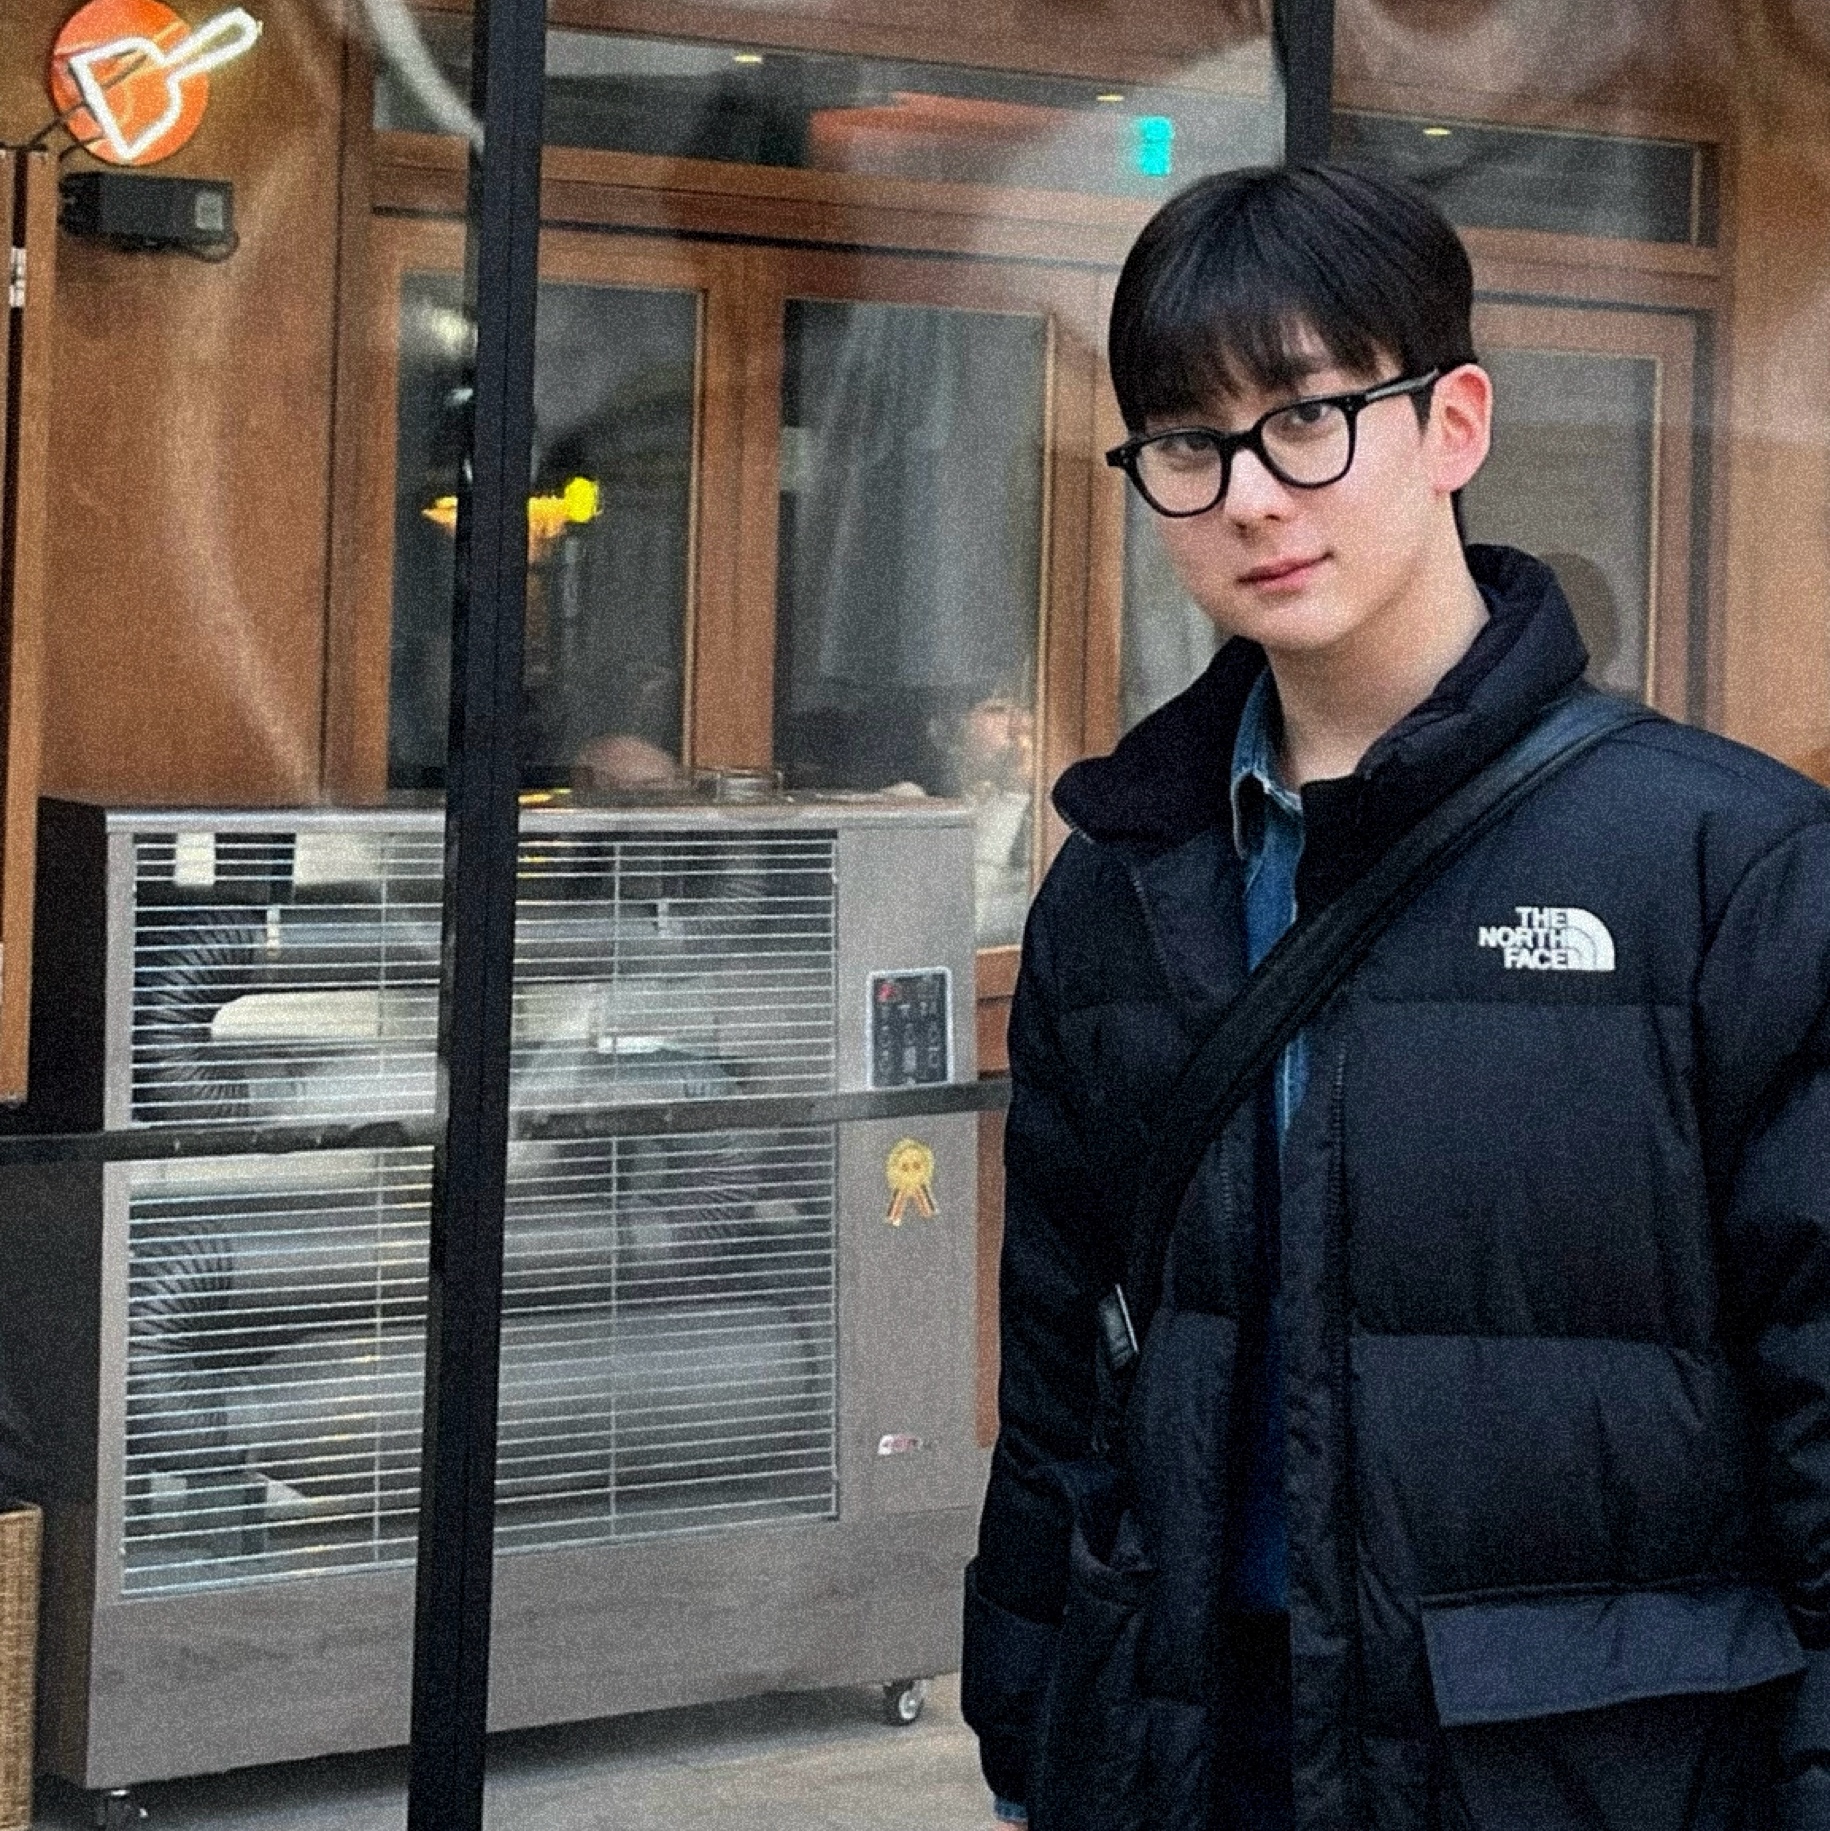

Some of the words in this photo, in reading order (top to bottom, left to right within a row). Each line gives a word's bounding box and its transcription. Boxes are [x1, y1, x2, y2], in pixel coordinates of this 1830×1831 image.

[1515, 906, 1568, 928] THE
[1478, 926, 1568, 948] NORTH
[1503, 948, 1568, 970] FACE
